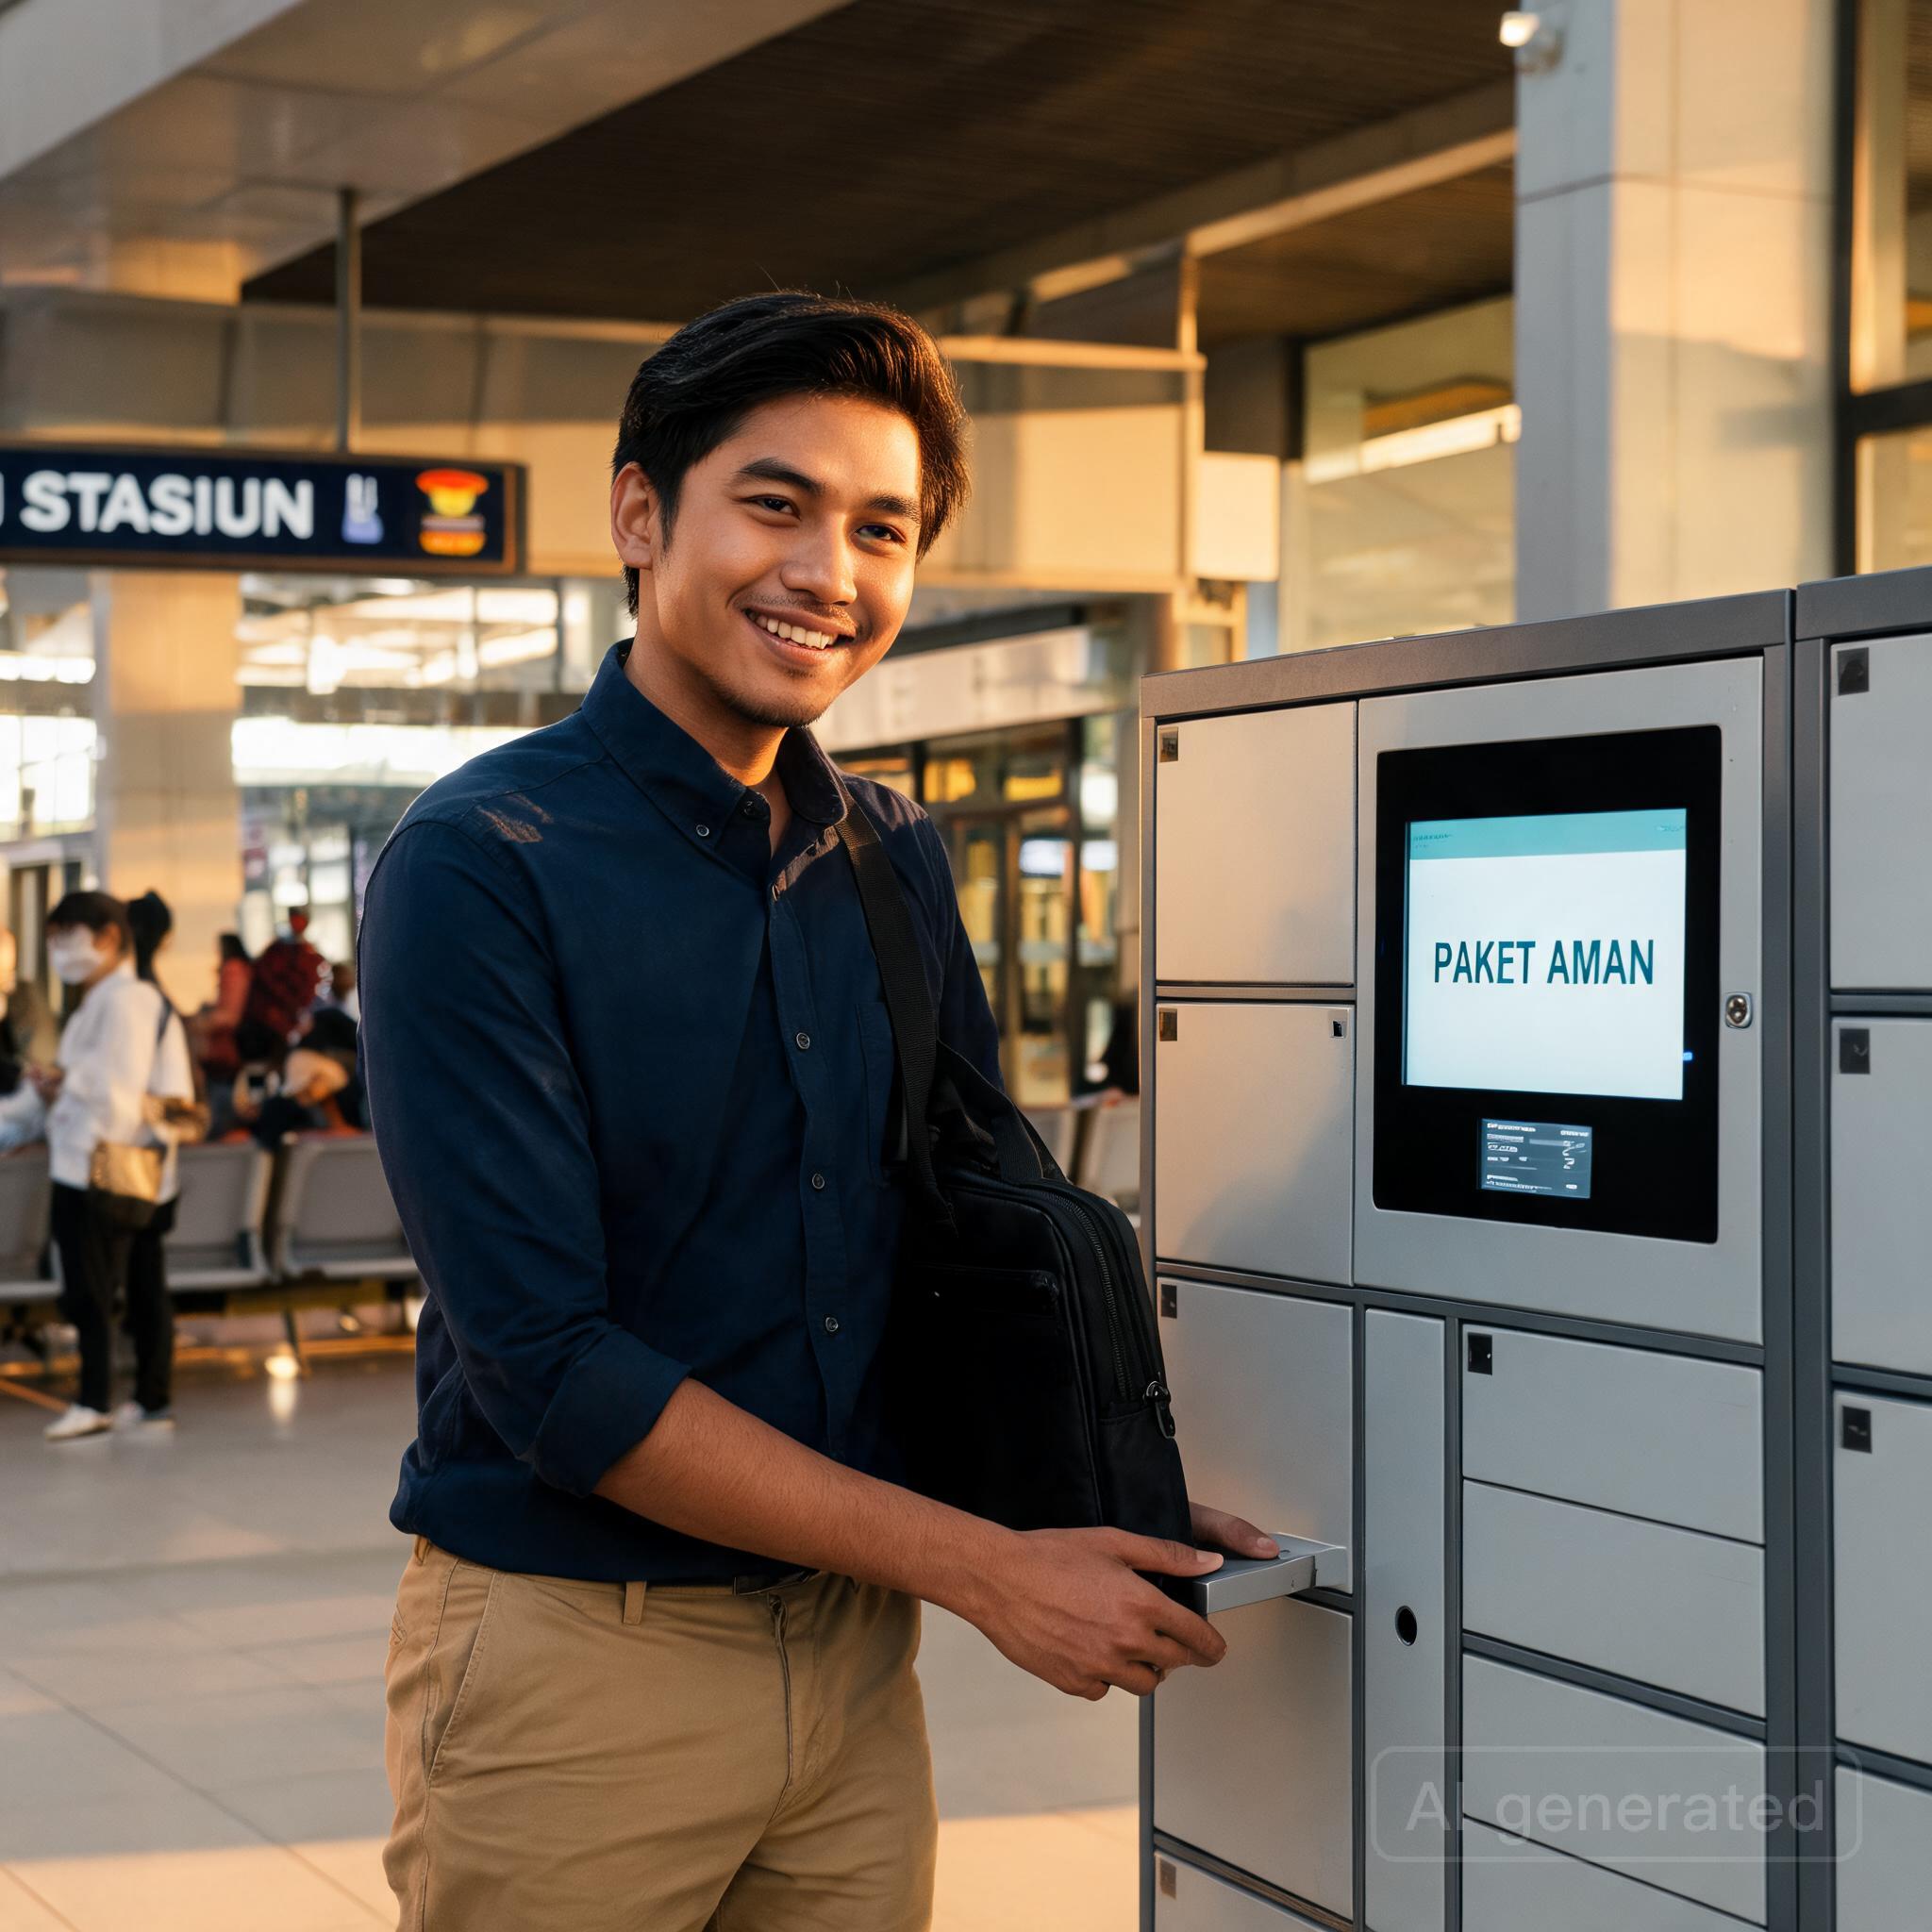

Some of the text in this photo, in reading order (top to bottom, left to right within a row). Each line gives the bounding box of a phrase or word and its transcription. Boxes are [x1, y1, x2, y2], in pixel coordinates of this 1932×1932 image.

[20, 470, 314, 539] STASIUN
[1434, 940, 1654, 985] PAKET AMAN
